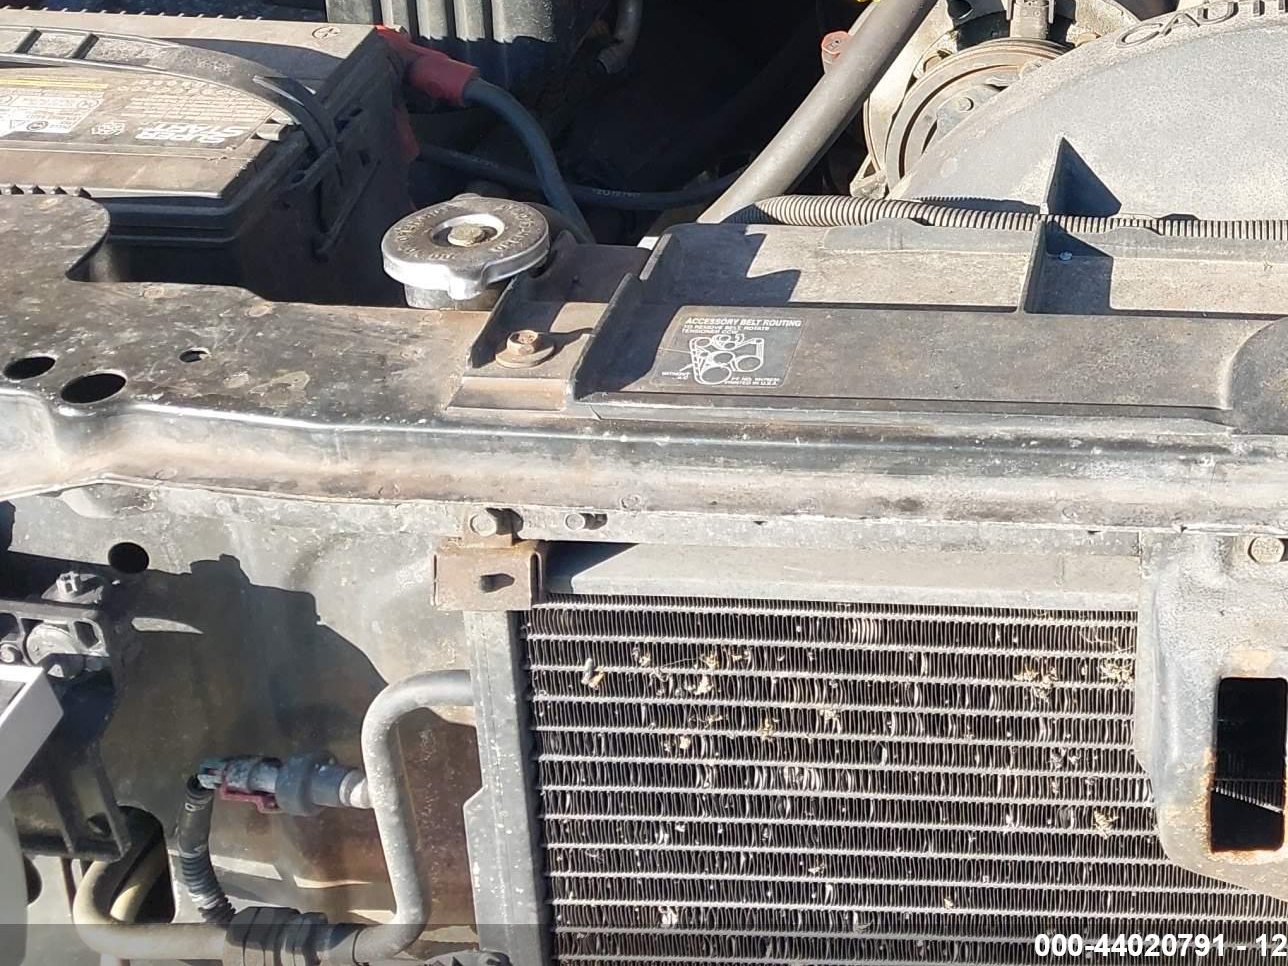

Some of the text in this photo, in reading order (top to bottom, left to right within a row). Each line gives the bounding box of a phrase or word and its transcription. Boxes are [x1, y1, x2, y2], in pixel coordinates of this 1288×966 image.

[135, 127, 225, 144] SUPER
[153, 122, 251, 138] START
[685, 318, 802, 327] ACCESSORY BELT ROUTING
